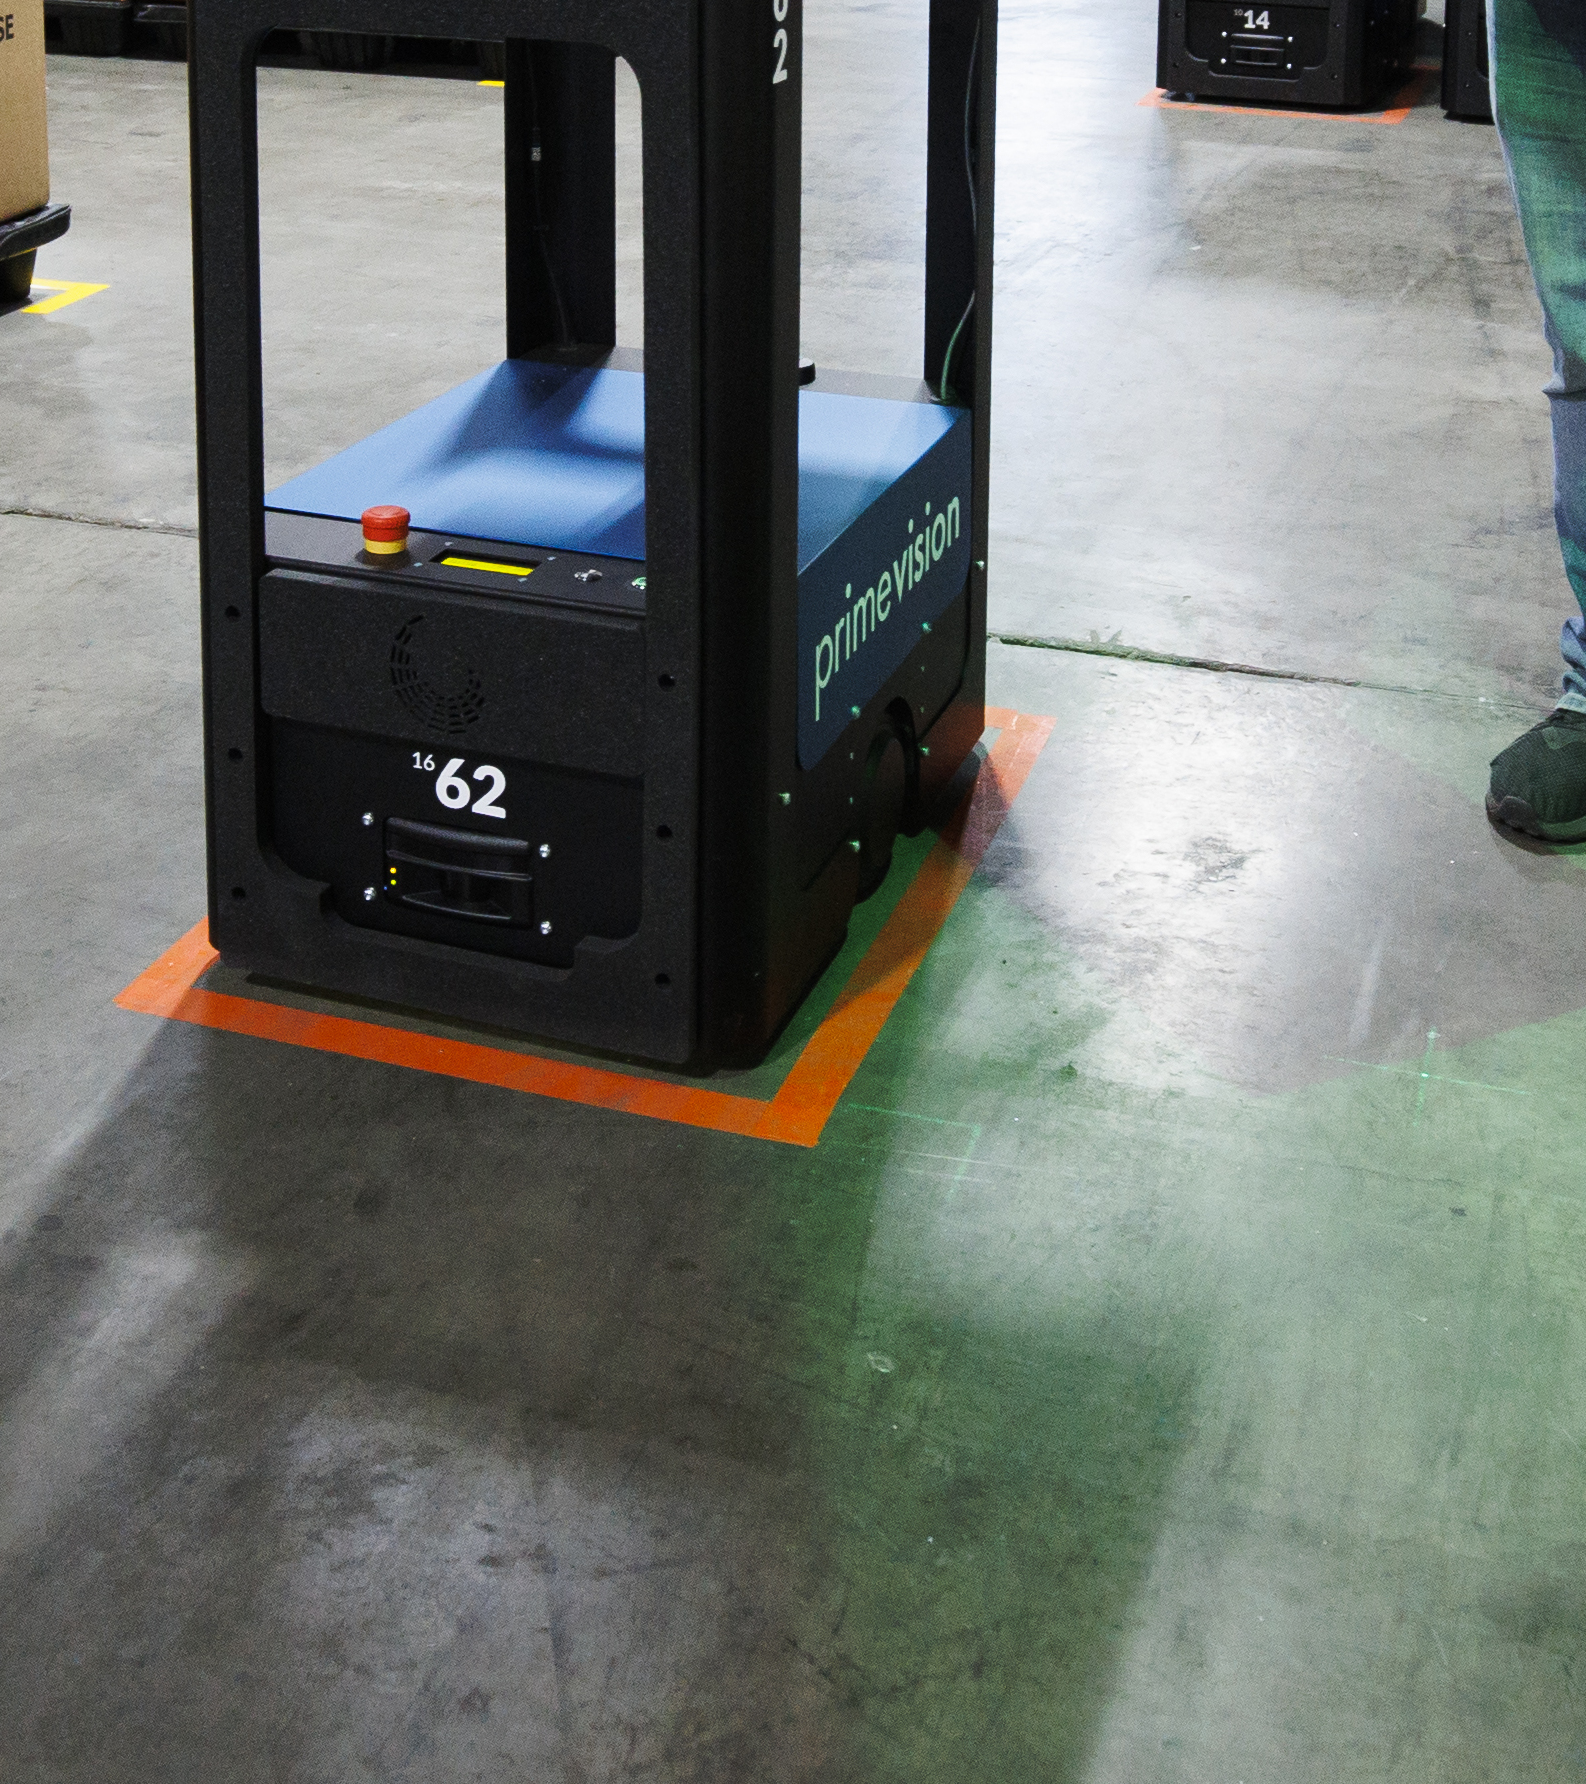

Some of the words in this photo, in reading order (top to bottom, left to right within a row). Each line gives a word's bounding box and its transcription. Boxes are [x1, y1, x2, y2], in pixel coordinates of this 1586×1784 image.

[1243, 9, 1271, 30] 14
[815, 496, 960, 722] primevision
[412, 751, 436, 772] 16
[435, 757, 507, 819] 62
